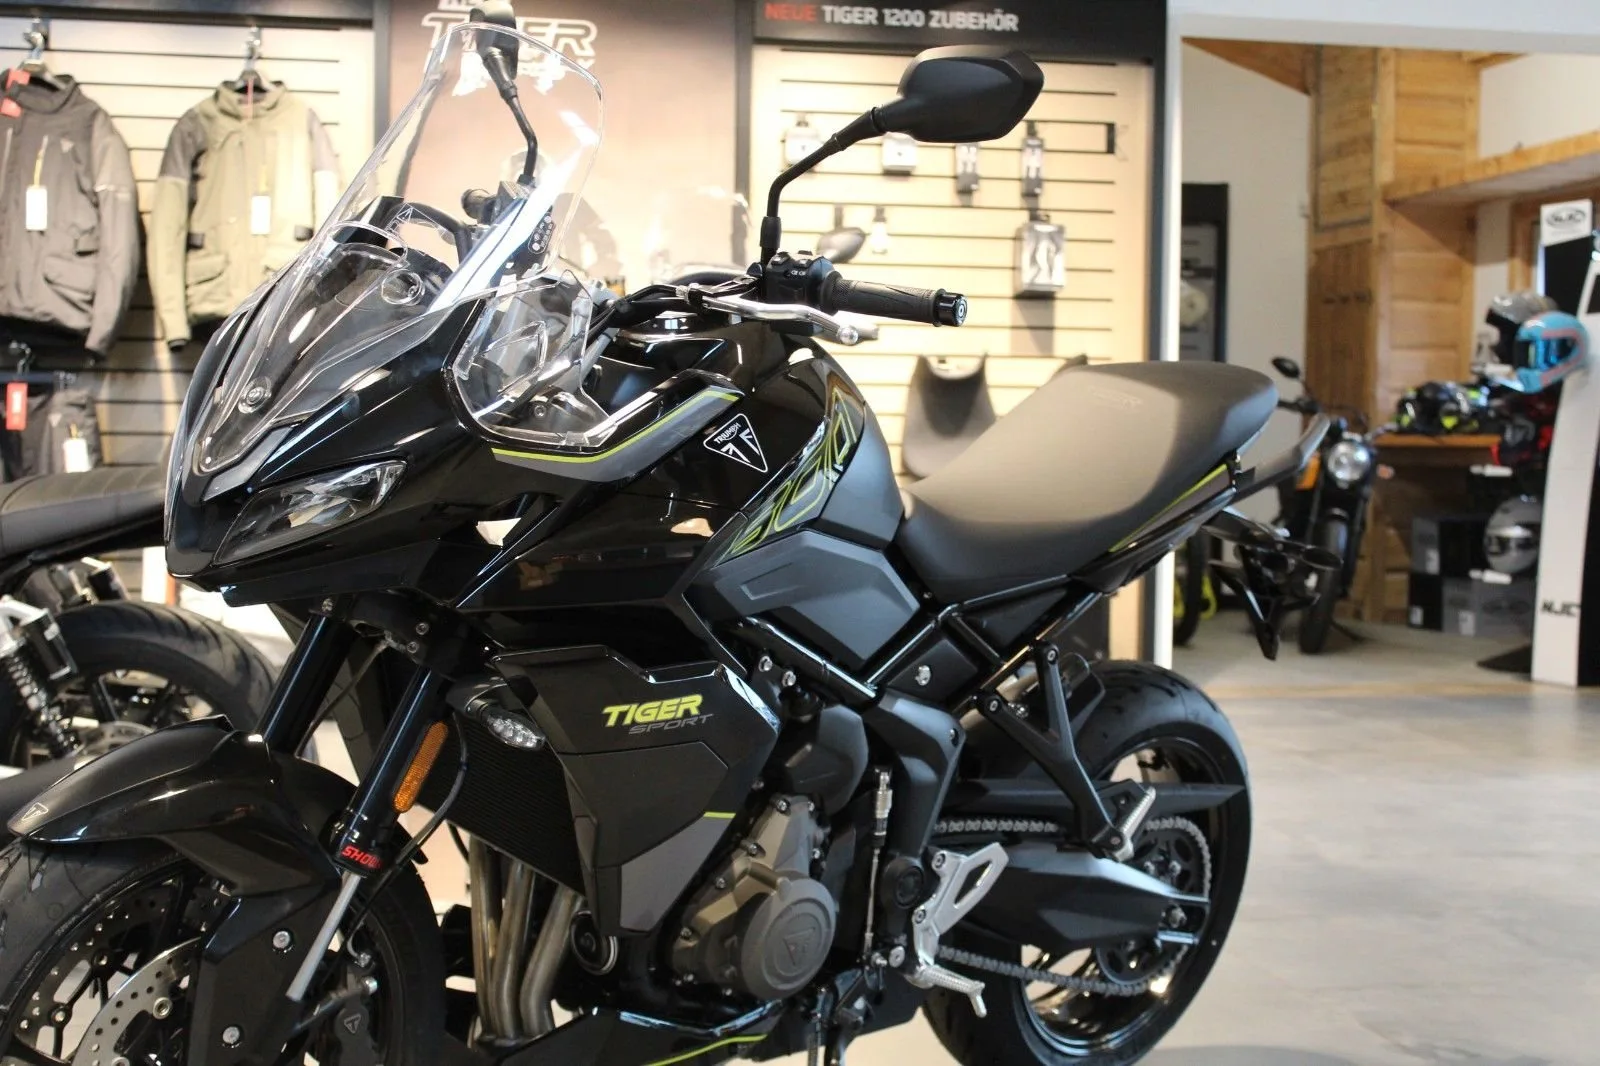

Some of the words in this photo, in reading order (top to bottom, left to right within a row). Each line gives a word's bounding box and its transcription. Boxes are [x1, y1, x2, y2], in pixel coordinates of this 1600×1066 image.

[764, 2, 817, 22] NEUE
[821, 4, 879, 26] TIGER
[882, 8, 925, 28] 1200
[928, 8, 1020, 32] ZUBEHÖR
[421, 12, 598, 62] TER
[713, 422, 742, 444] TRIUMPH
[601, 694, 703, 728] TIGER
[628, 713, 715, 735] SPORT
